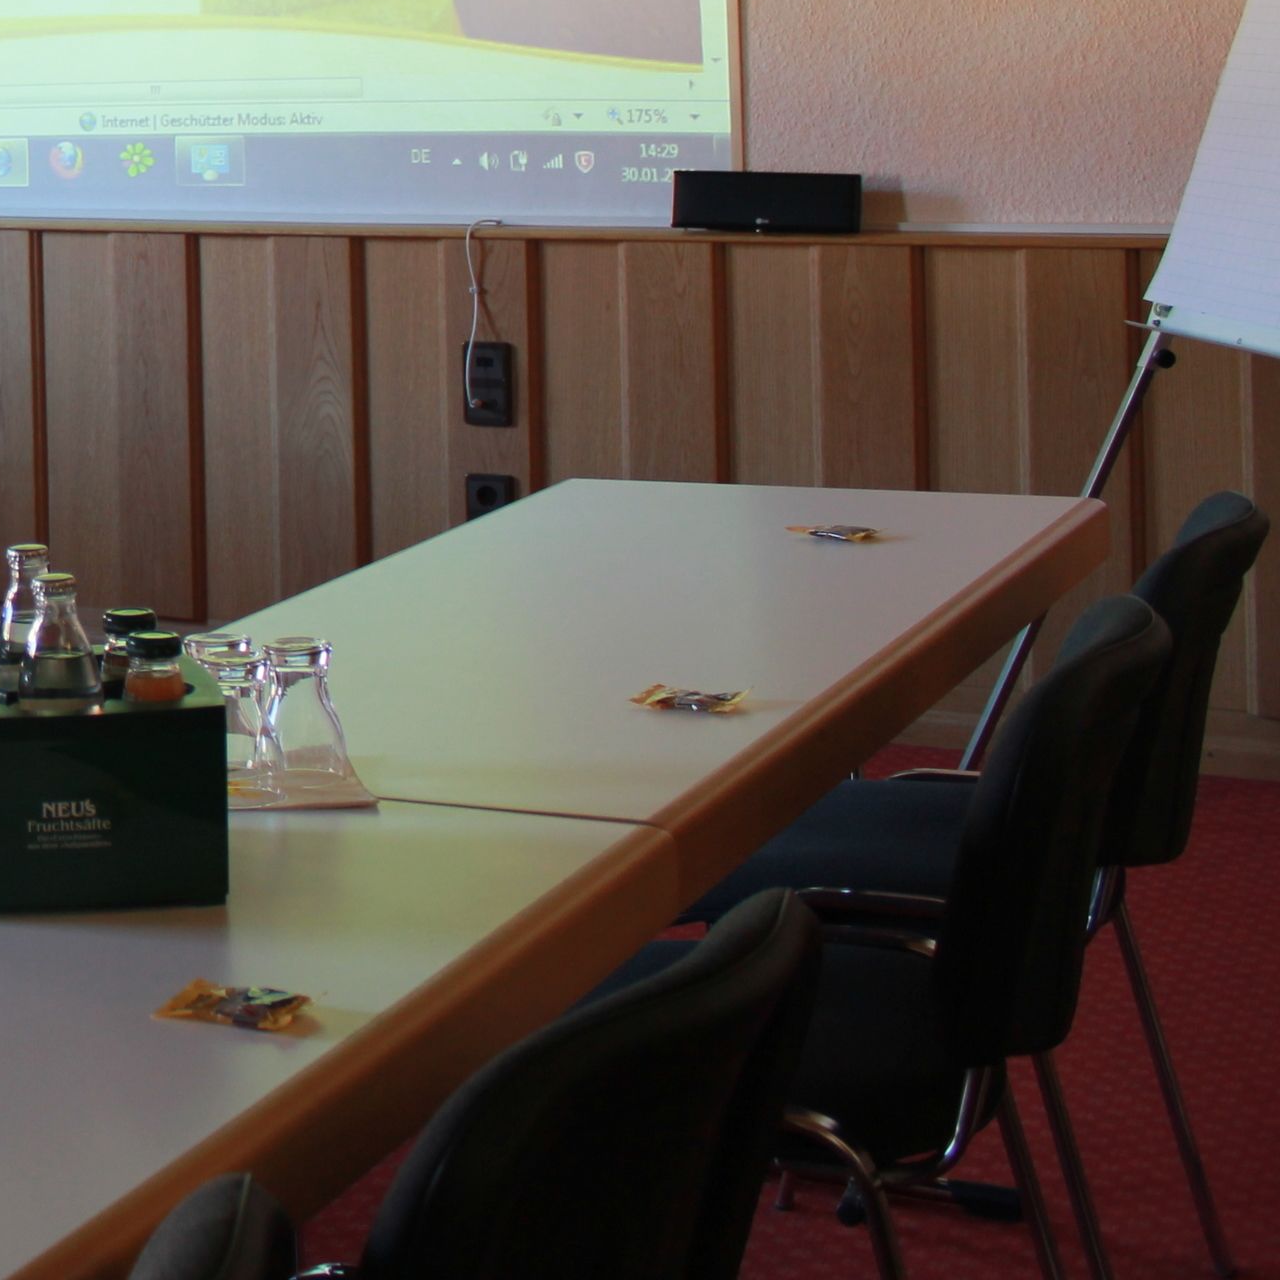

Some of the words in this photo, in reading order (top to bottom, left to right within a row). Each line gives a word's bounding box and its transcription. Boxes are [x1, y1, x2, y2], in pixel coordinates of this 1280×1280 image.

[101, 114, 150, 129] Internet
[160, 113, 234, 129] Geschützter
[237, 113, 286, 128] Modus:
[290, 112, 323, 127] Aktiv
[627, 108, 668, 124] 175%
[411, 149, 431, 164] DE
[640, 144, 679, 158] 14:29
